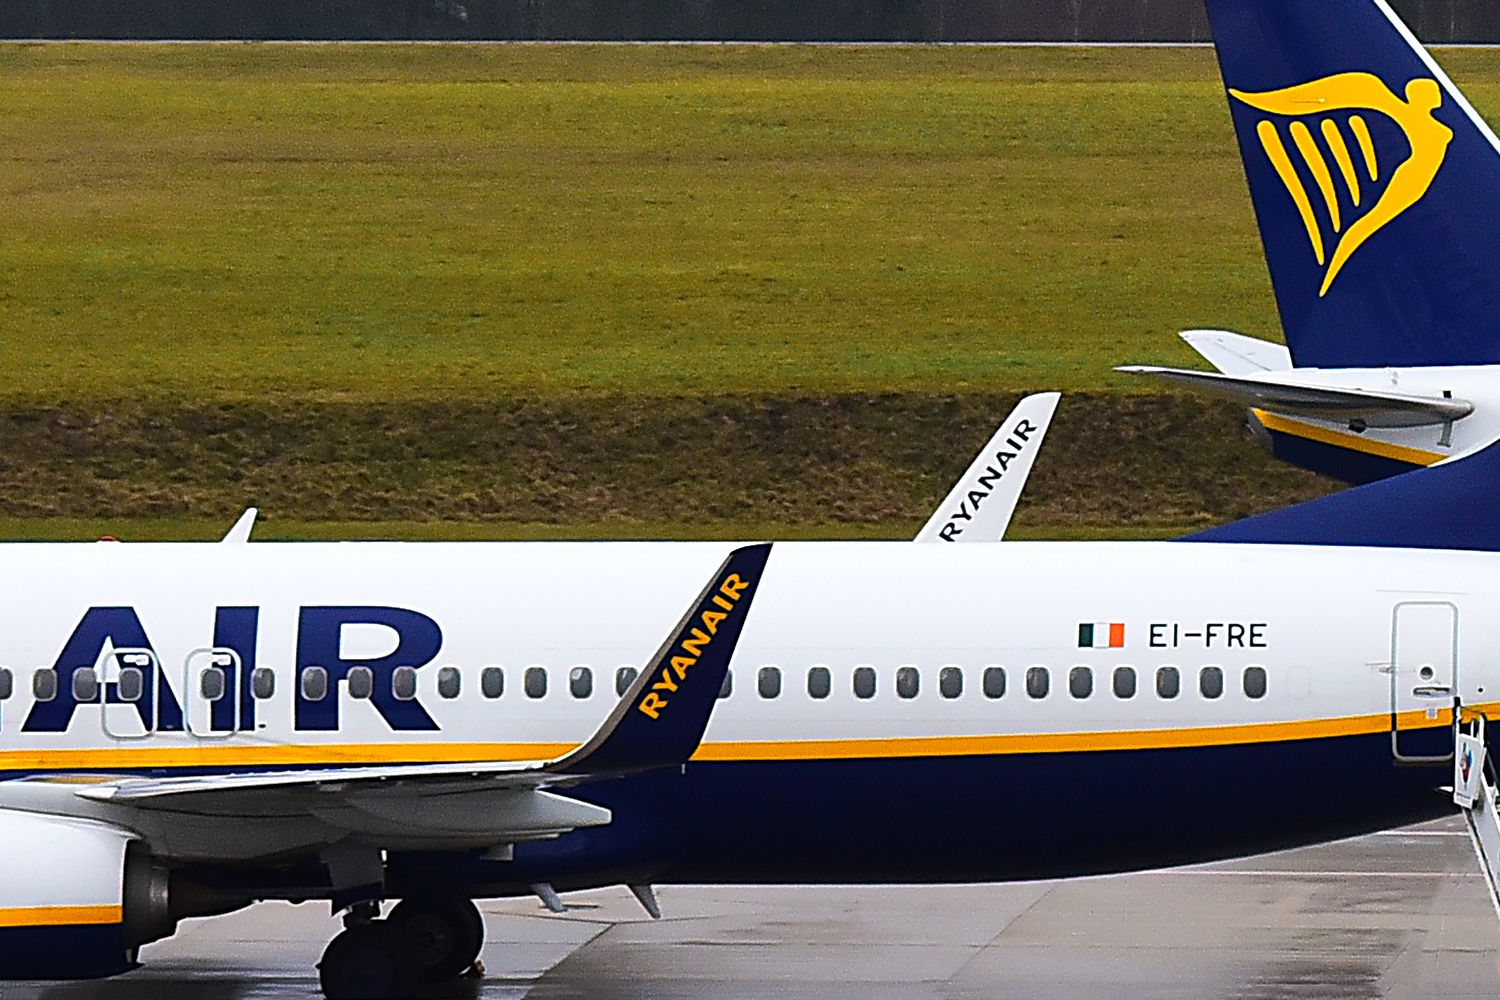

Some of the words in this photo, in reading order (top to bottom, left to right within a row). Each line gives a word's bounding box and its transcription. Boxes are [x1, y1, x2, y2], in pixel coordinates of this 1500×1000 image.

[938, 419, 1038, 542] RYANAIR
[20, 605, 443, 733] AIR
[639, 573, 749, 719] RYANAIR
[1149, 623, 1267, 648] EI-FRE
